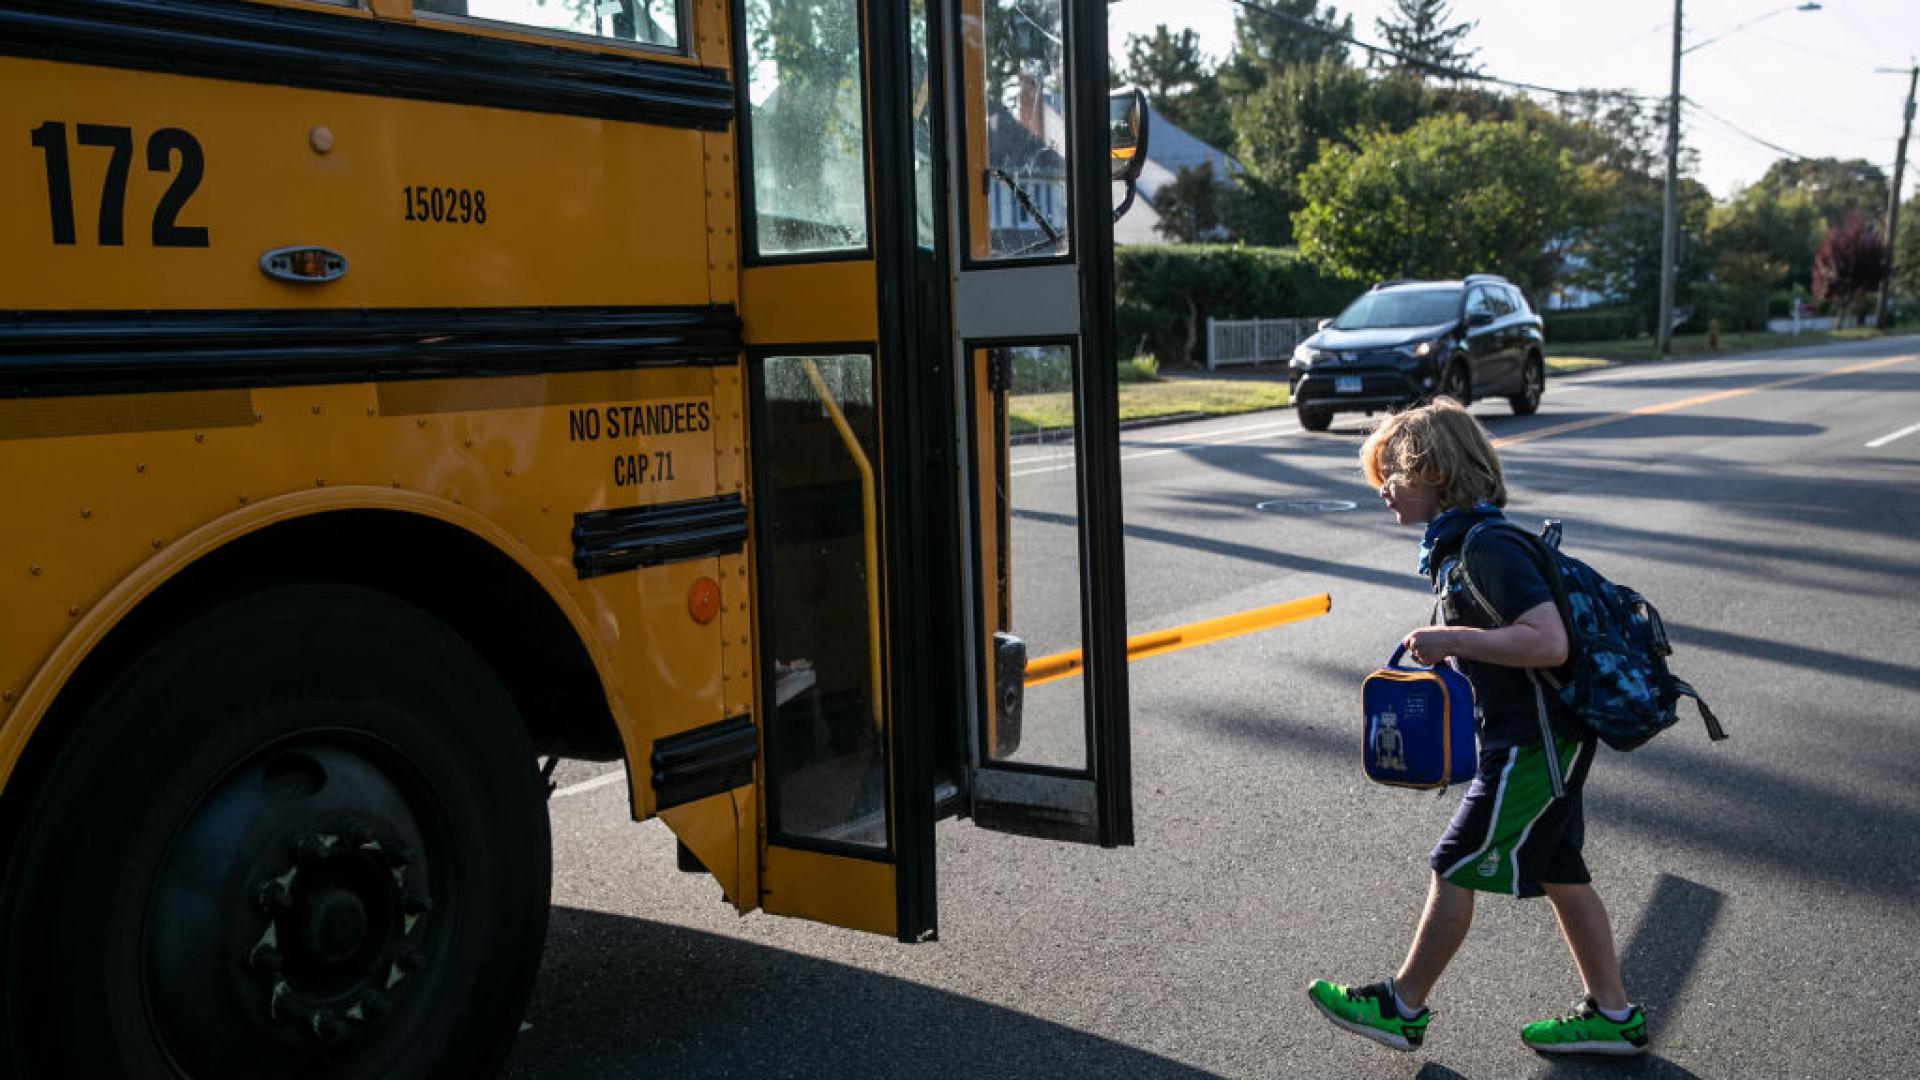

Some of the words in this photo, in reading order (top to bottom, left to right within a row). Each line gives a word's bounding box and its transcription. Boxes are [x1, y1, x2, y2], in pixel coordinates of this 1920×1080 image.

[31, 121, 210, 248] 172
[404, 186, 486, 224] 150298
[569, 408, 600, 441] NO
[606, 402, 710, 439] STANDEES
